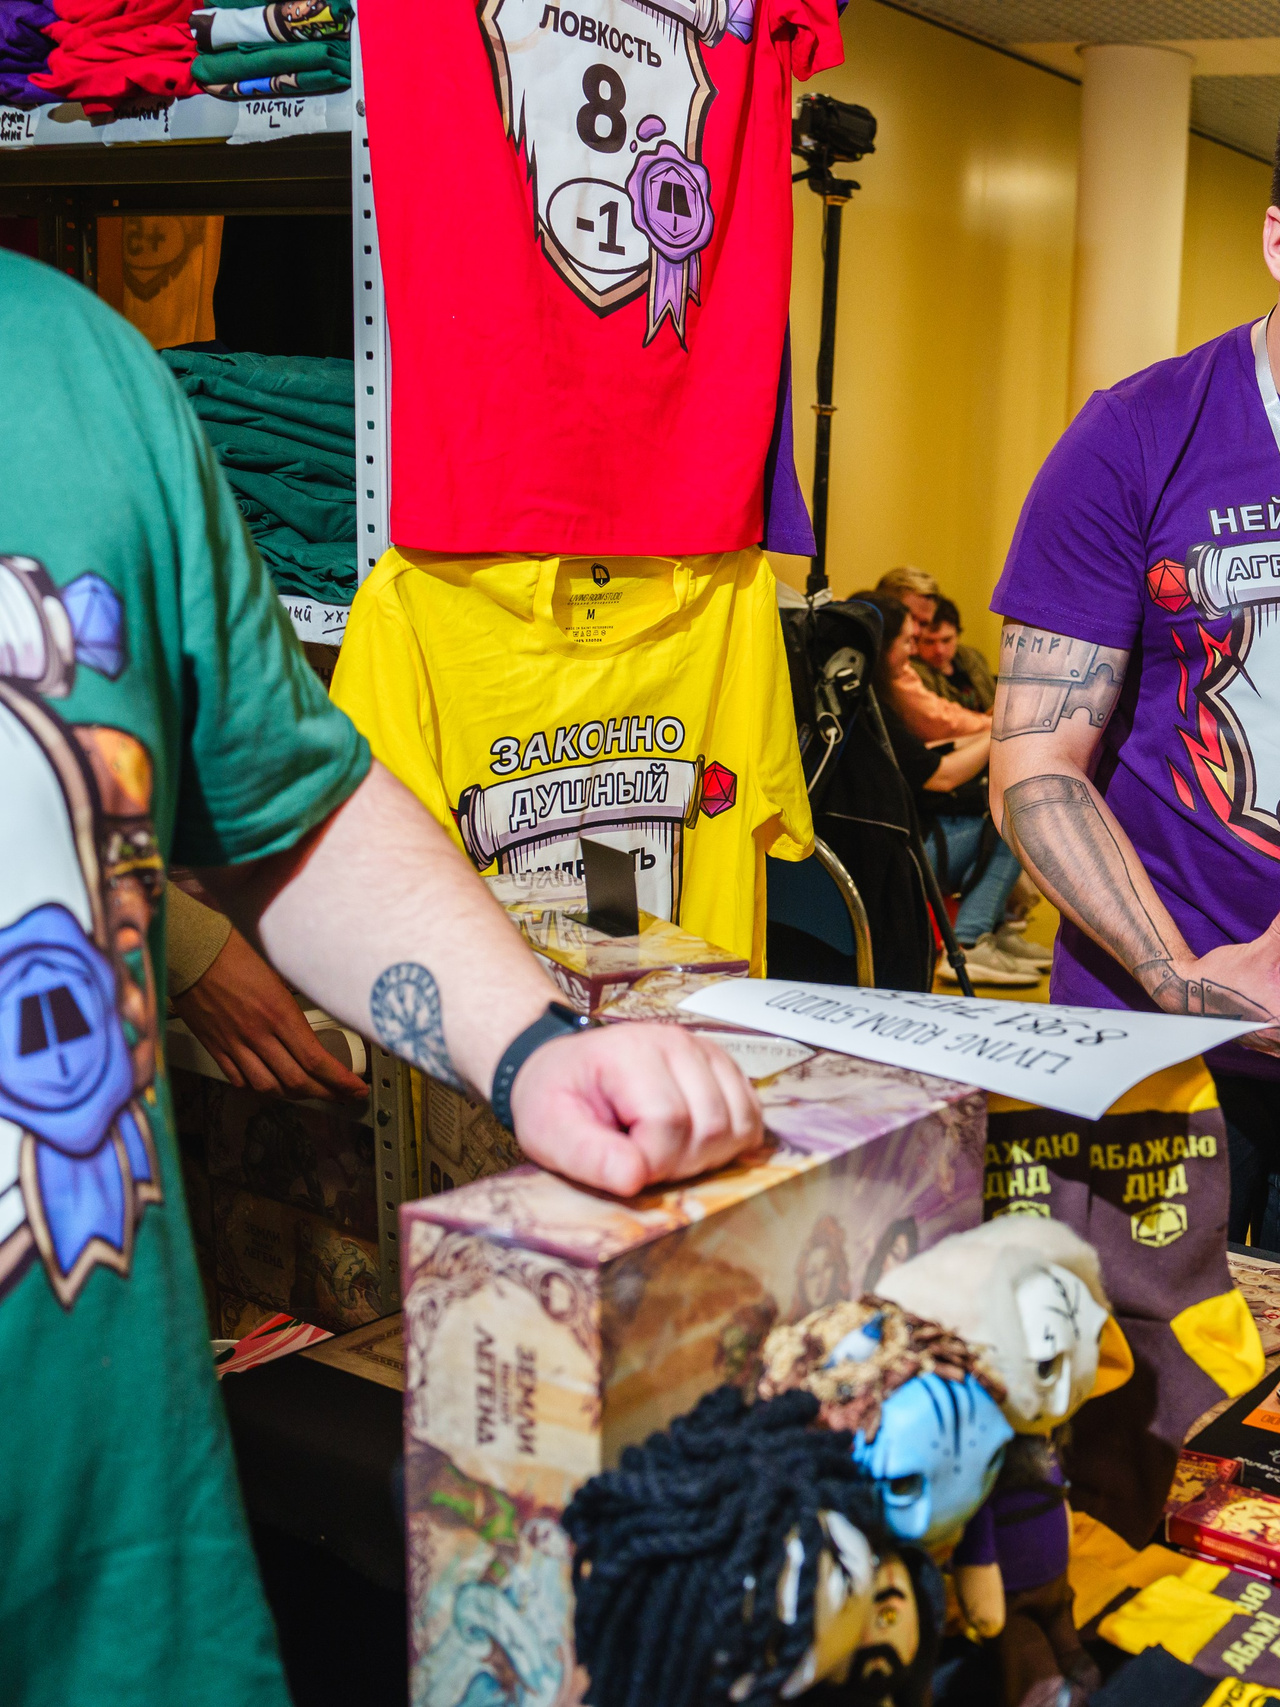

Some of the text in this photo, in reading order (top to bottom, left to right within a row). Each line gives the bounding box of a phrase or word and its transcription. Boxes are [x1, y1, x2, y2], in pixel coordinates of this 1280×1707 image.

[539, 4, 662, 67] ЛОВКОСТЬ
[269, 116, 280, 128] L
[576, 63, 627, 153] 8
[576, 201, 625, 256] -1
[587, 609, 595, 620] M
[490, 716, 686, 776] ЗАКОННО
[509, 763, 669, 833] ДУШНЫЙ
[765, 988, 870, 1025] STUDIO
[852, 1011, 948, 1046] ROOM
[944, 1033, 1072, 1074] LIVING
[985, 1131, 1080, 1165] АЖАЮ
[1089, 1134, 1217, 1171] АБАЖАЮ
[1122, 1163, 1189, 1204] ДНД
